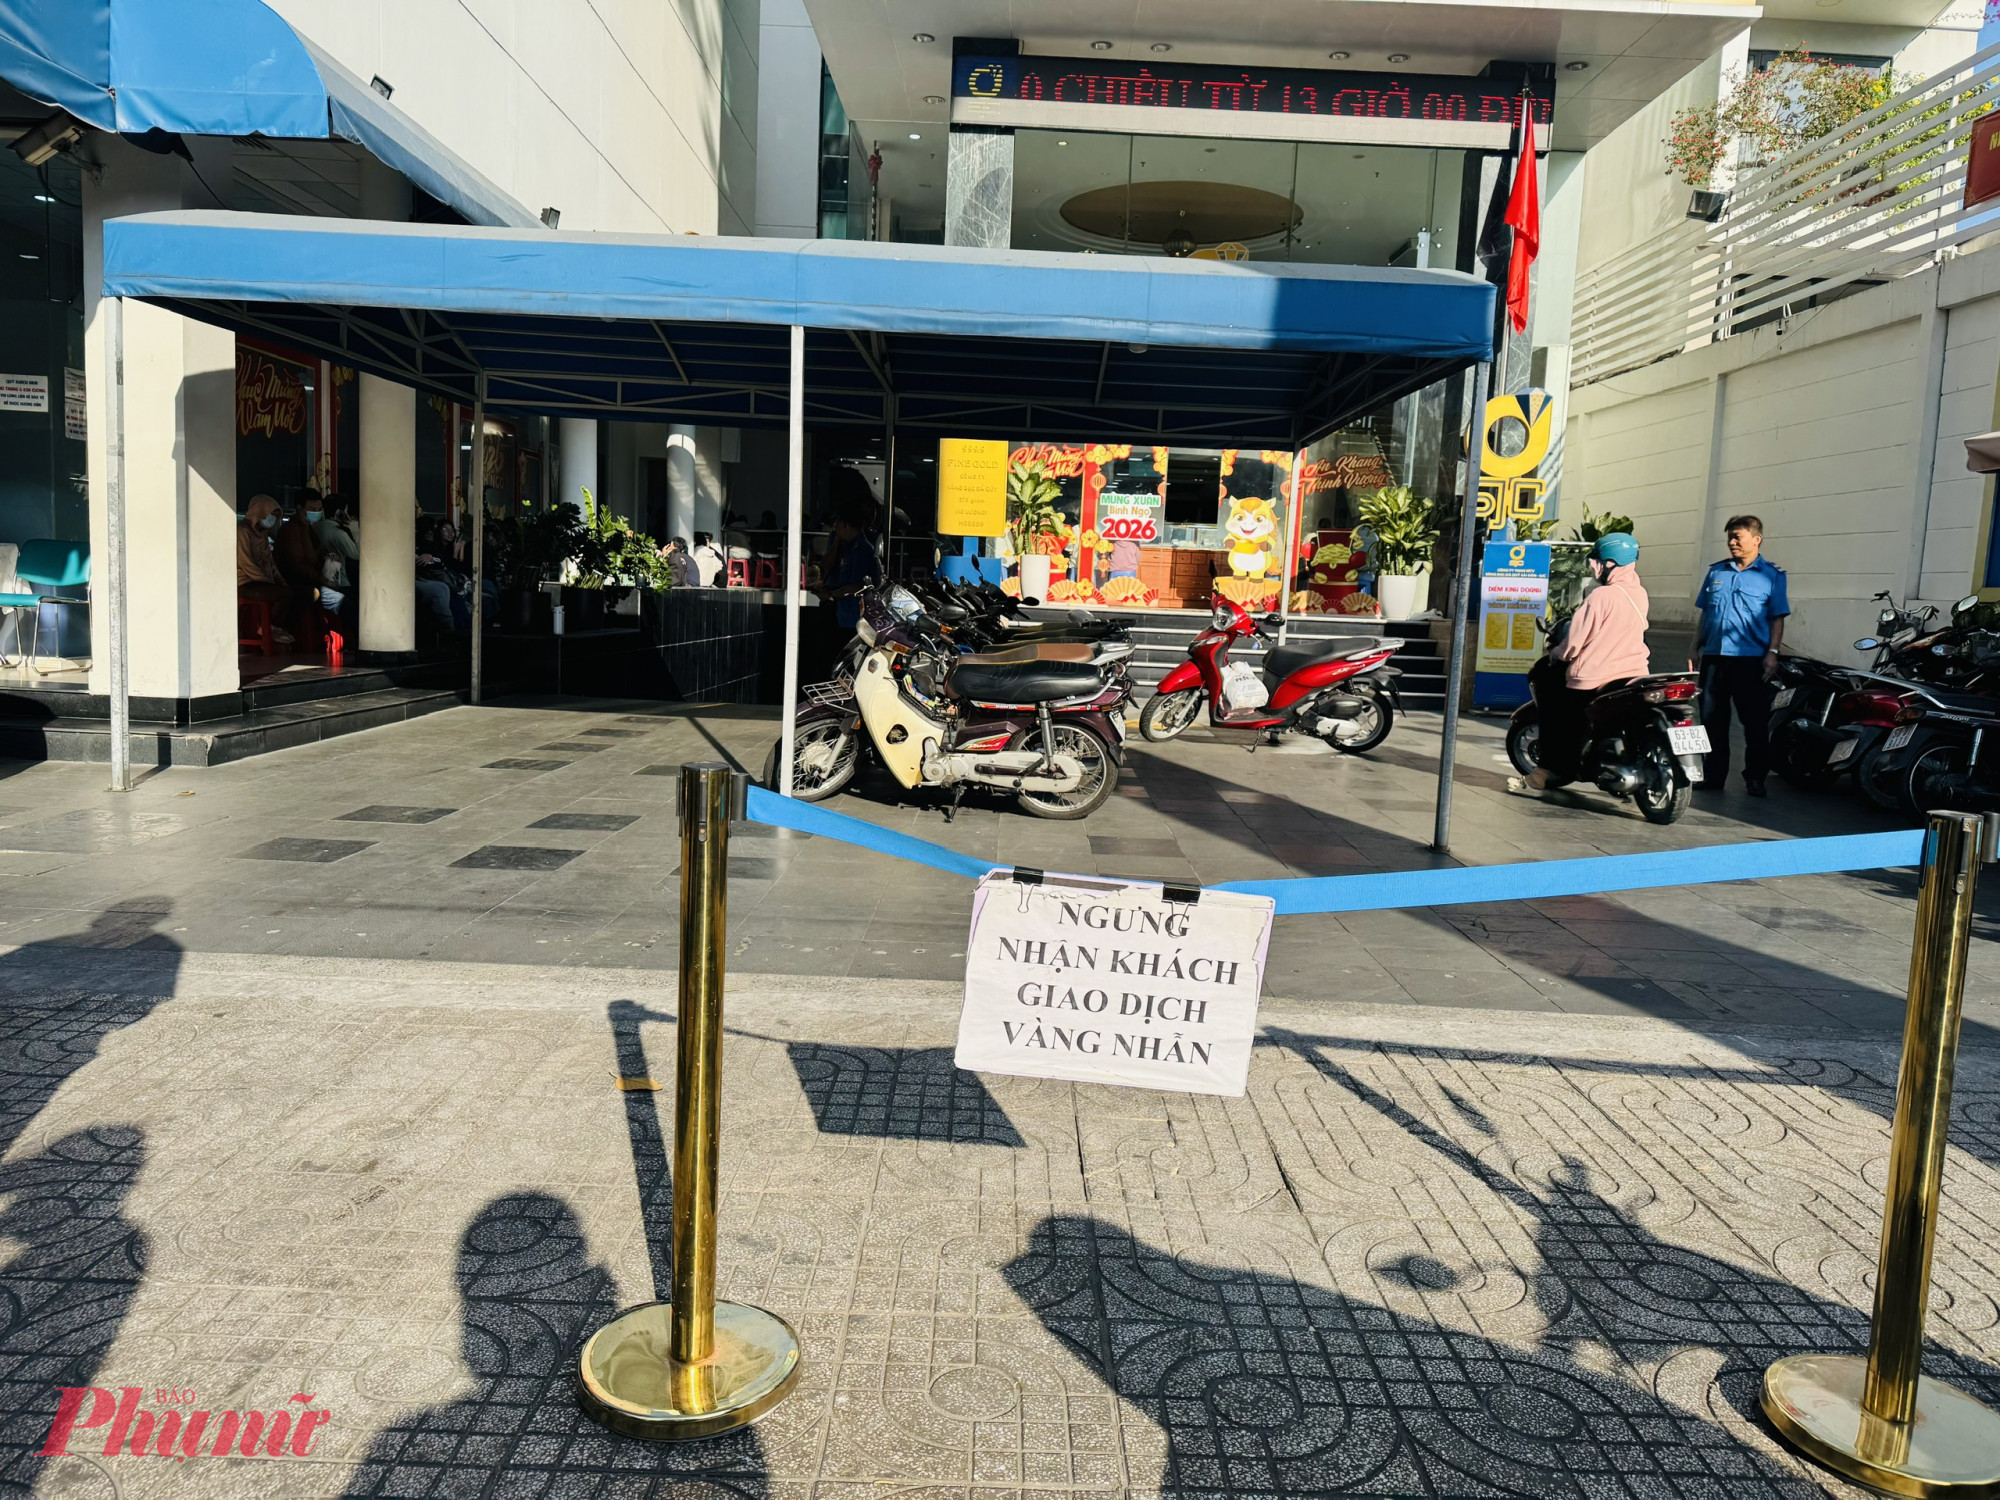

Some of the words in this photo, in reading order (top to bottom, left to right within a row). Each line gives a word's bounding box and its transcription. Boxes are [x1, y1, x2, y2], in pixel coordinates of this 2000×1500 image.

[972, 460, 999, 469] GOLD
[1336, 455, 1381, 473] Khang
[1101, 517, 1156, 540] 2026
[1057, 901, 1191, 938] NGƯNG
[997, 936, 1100, 973] NHẬN
[1109, 948, 1240, 985] KHÁCH
[1017, 982, 1109, 1013] GIAO
[1119, 991, 1208, 1025] DỊCH
[1002, 1017, 1101, 1054] VÀNG
[1112, 1032, 1214, 1065] NHẪN
